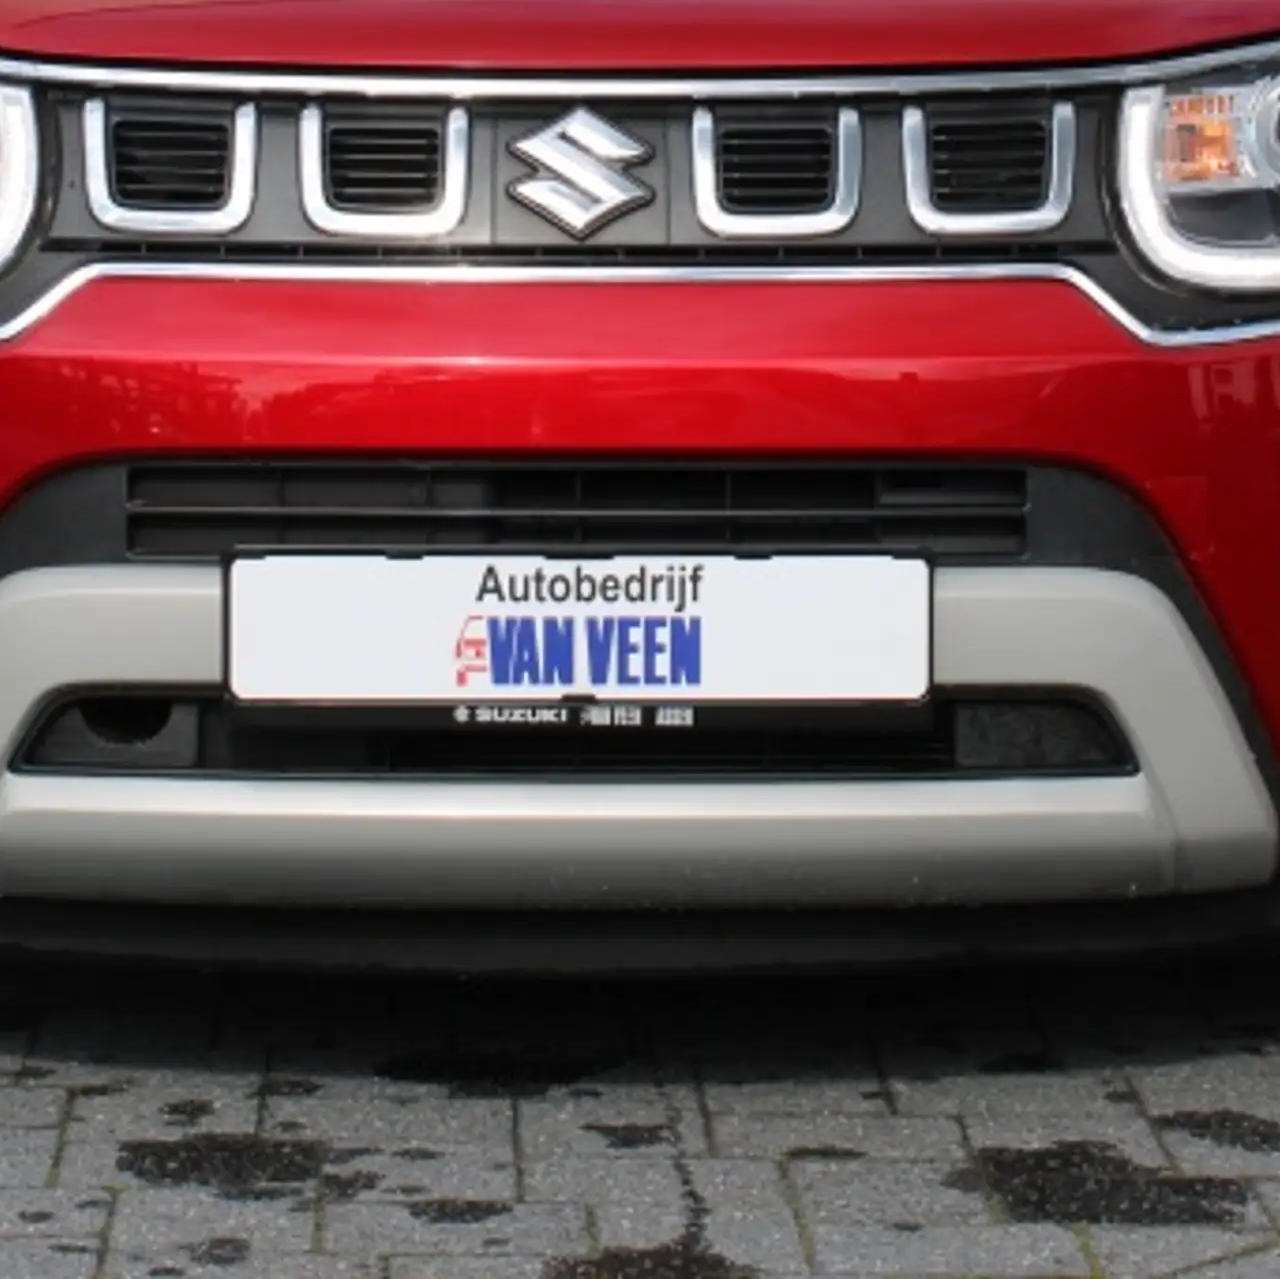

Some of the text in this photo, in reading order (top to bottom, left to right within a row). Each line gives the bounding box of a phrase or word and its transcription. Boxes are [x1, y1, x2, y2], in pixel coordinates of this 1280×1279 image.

[475, 564, 704, 613] Autobedrijf
[486, 616, 702, 686] VAN VEEN
[475, 706, 568, 722] SUZUKI
